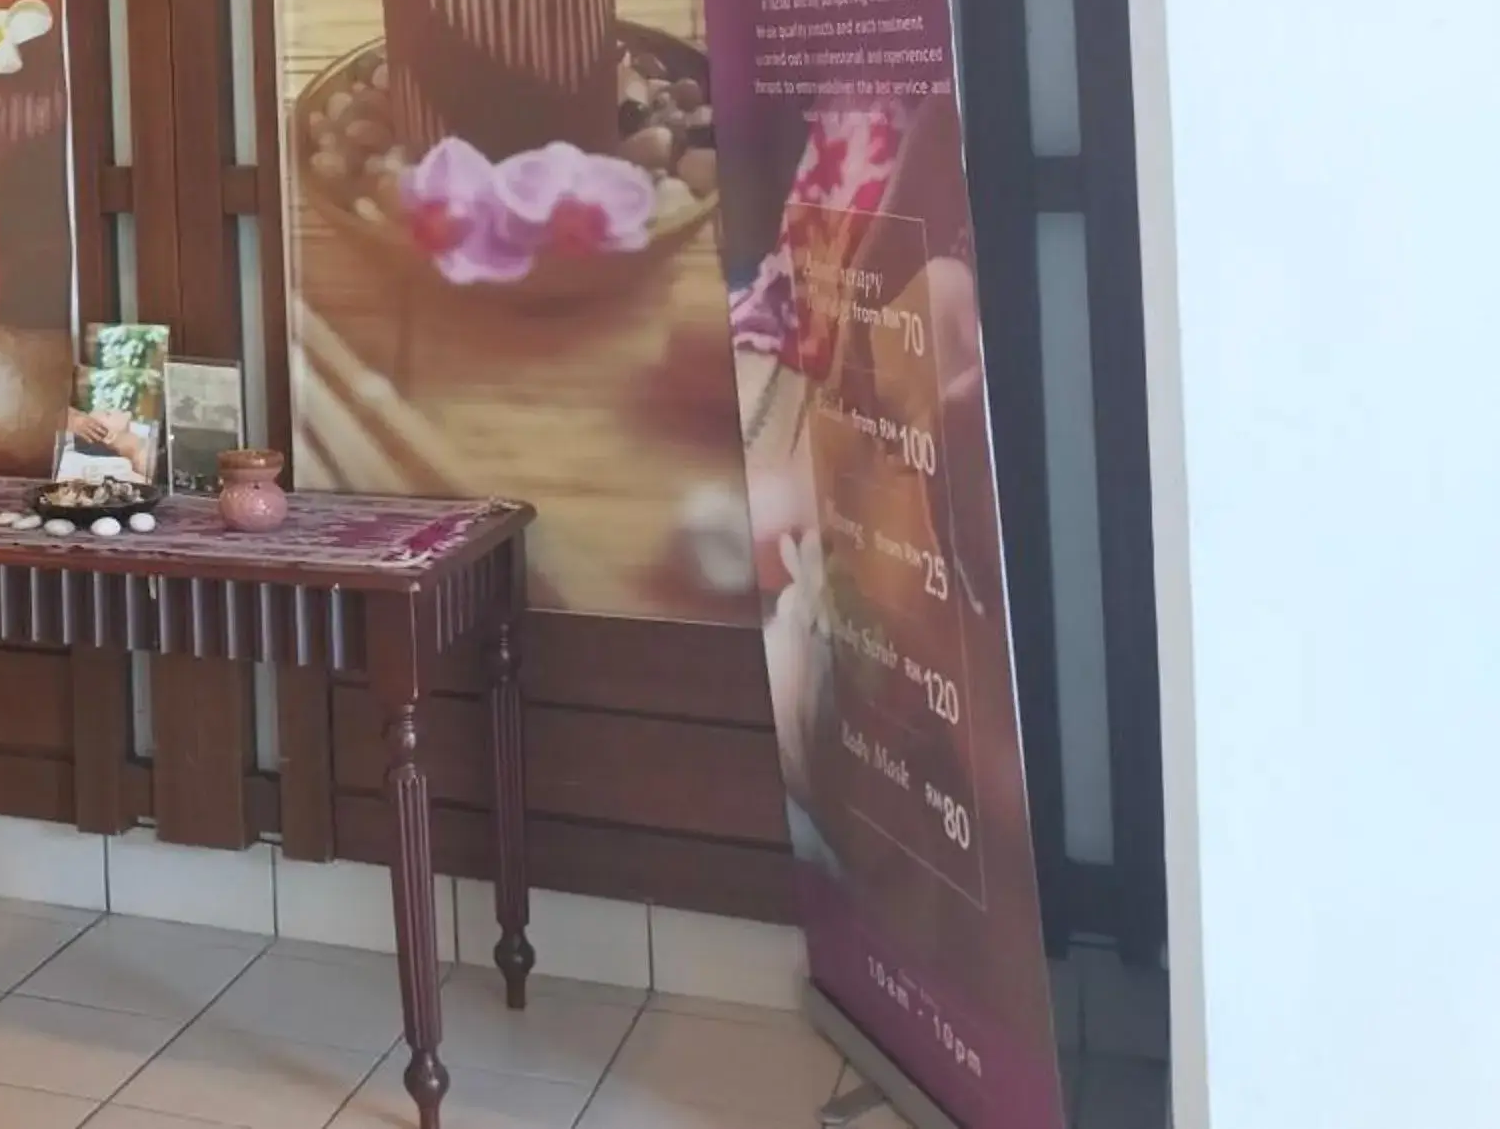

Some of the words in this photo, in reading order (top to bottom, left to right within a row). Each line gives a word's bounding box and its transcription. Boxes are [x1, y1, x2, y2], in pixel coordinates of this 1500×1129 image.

[900, 310, 924, 357] 70
[899, 424, 936, 477] 100
[922, 550, 948, 601] 25
[924, 668, 959, 725] 120
[943, 794, 970, 850] 80
[868, 954, 910, 1012] 10am
[933, 1014, 982, 1079] 10pm
